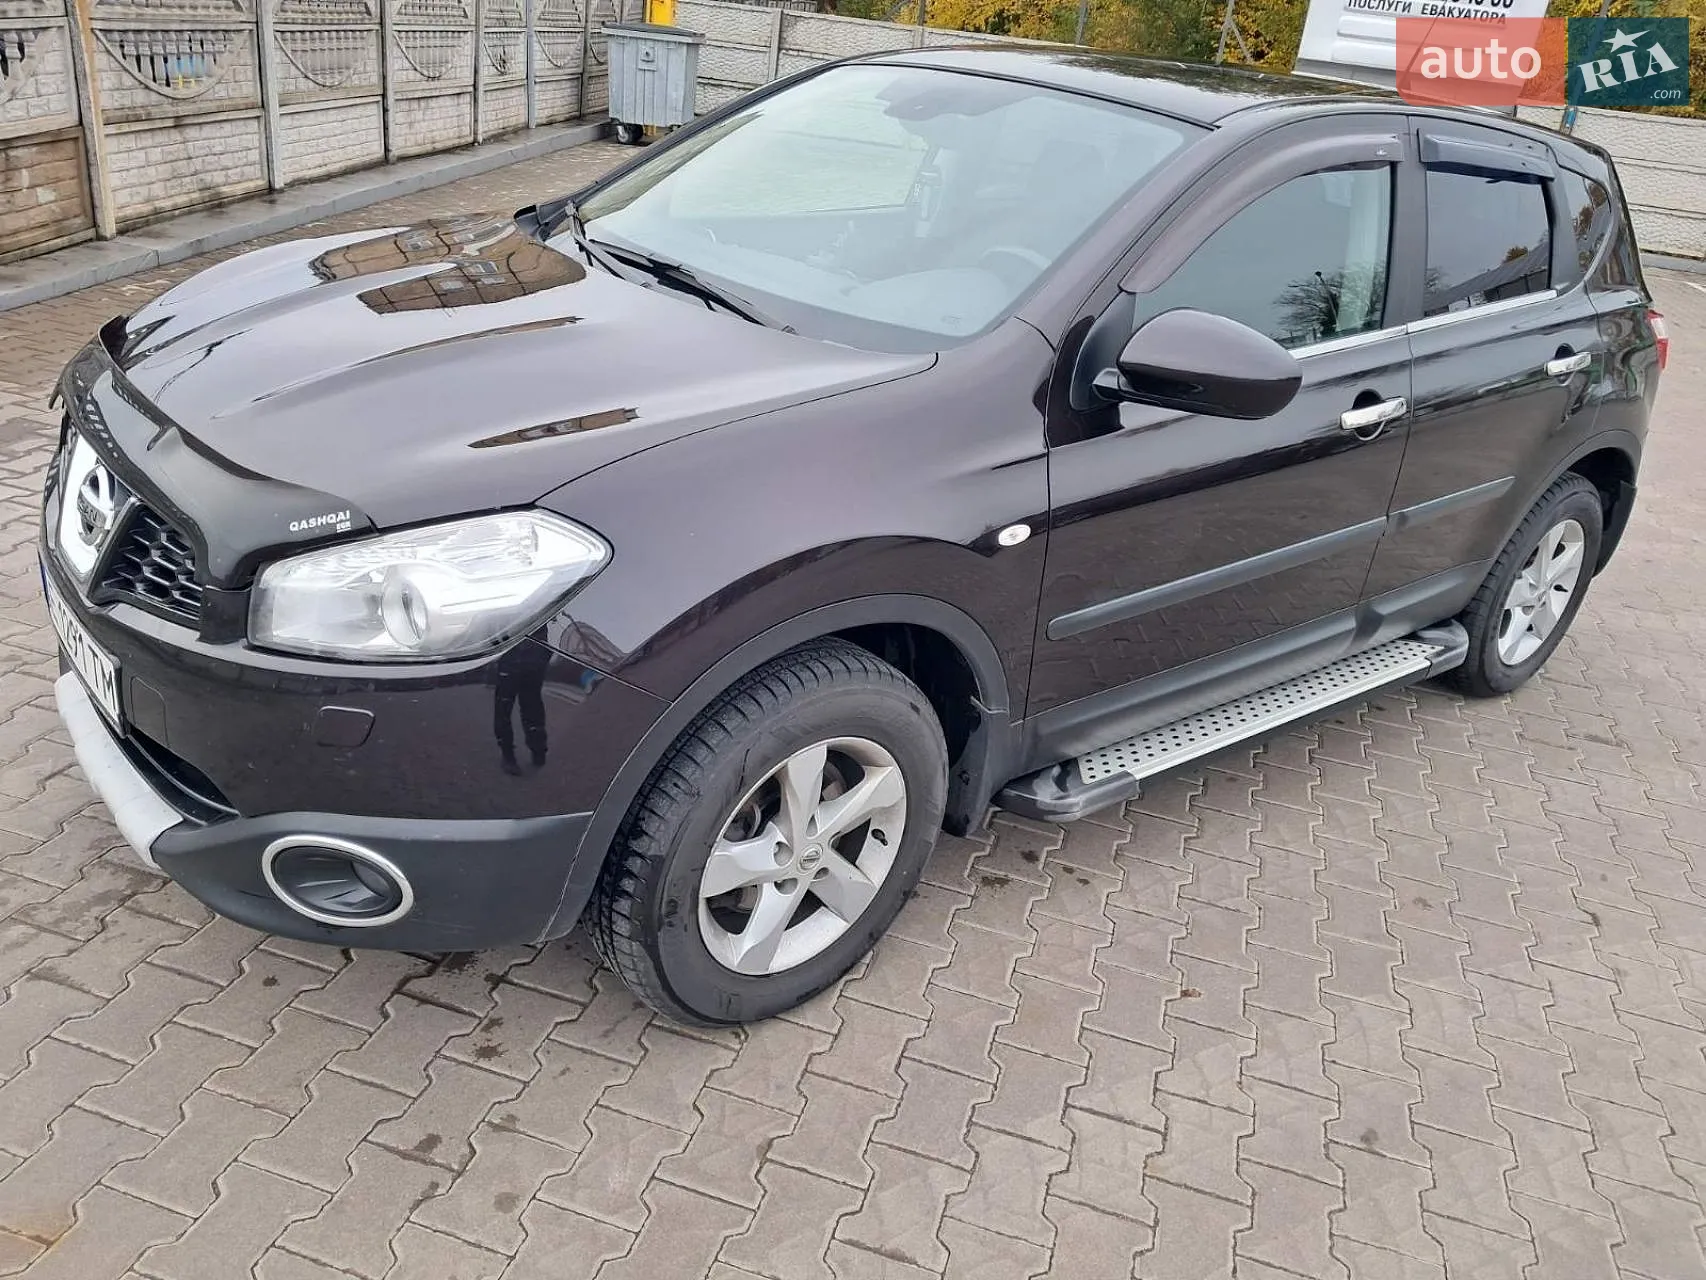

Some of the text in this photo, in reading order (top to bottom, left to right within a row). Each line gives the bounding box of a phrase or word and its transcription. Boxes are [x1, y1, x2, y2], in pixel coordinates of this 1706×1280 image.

[1348, 0, 1413, 13] ПОСЛУГИ
[1421, 3, 1507, 25] ЕВАКУАТОРА
[289, 510, 351, 532] QASHQAI
[88, 643, 117, 713] TM
